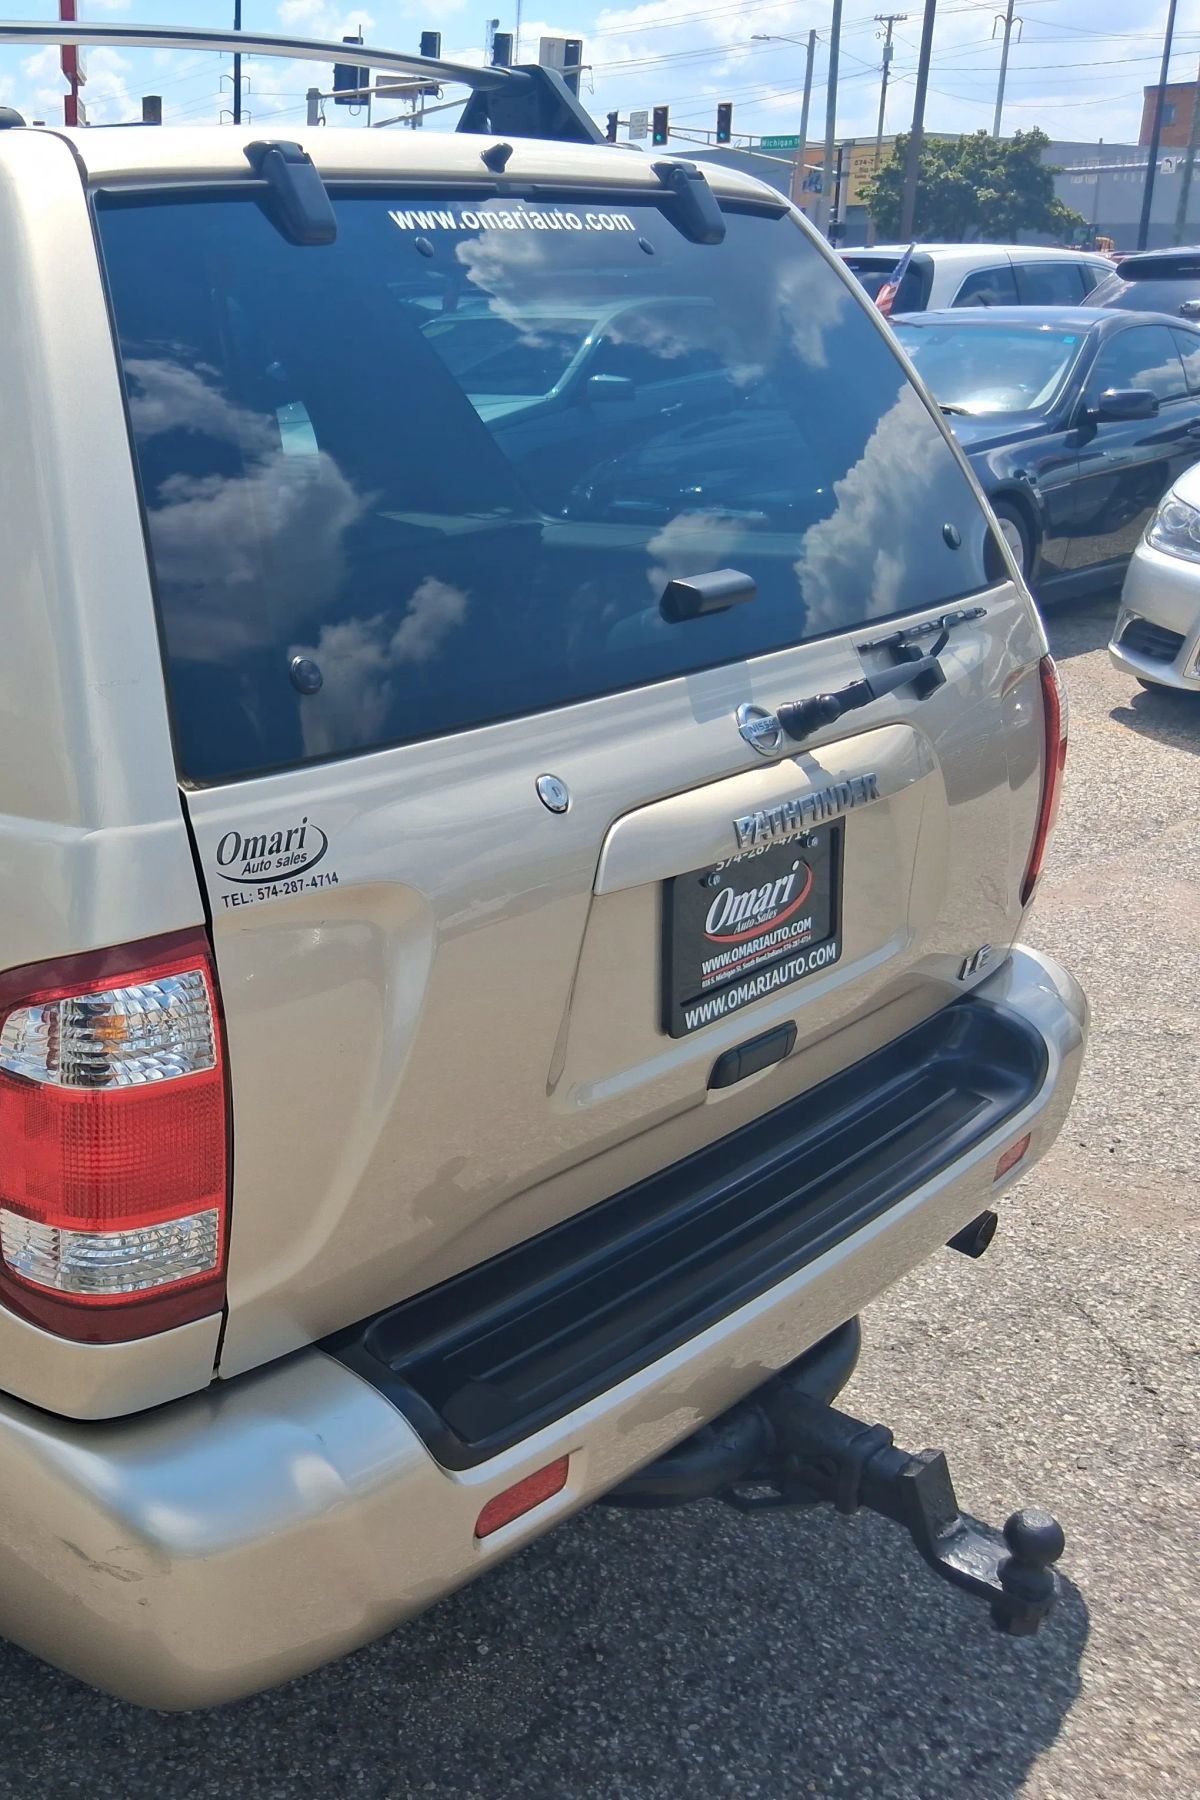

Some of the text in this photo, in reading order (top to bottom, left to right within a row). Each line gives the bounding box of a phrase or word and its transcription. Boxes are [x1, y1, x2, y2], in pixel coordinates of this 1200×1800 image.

[761, 139, 793, 148] Michigan
[388, 206, 635, 231] www.omariauto.com
[733, 773, 880, 849] PATHFINDER
[216, 817, 308, 866] Omari
[241, 852, 308, 876] Auto sales
[221, 872, 339, 908] TEL: 574-287-4714
[705, 860, 799, 934] Omari
[733, 909, 778, 935] Auto Sales
[702, 917, 812, 975] WWW.OMARIAUTO.COM
[685, 943, 837, 1029] WWW.OMARIAUTO.COM
